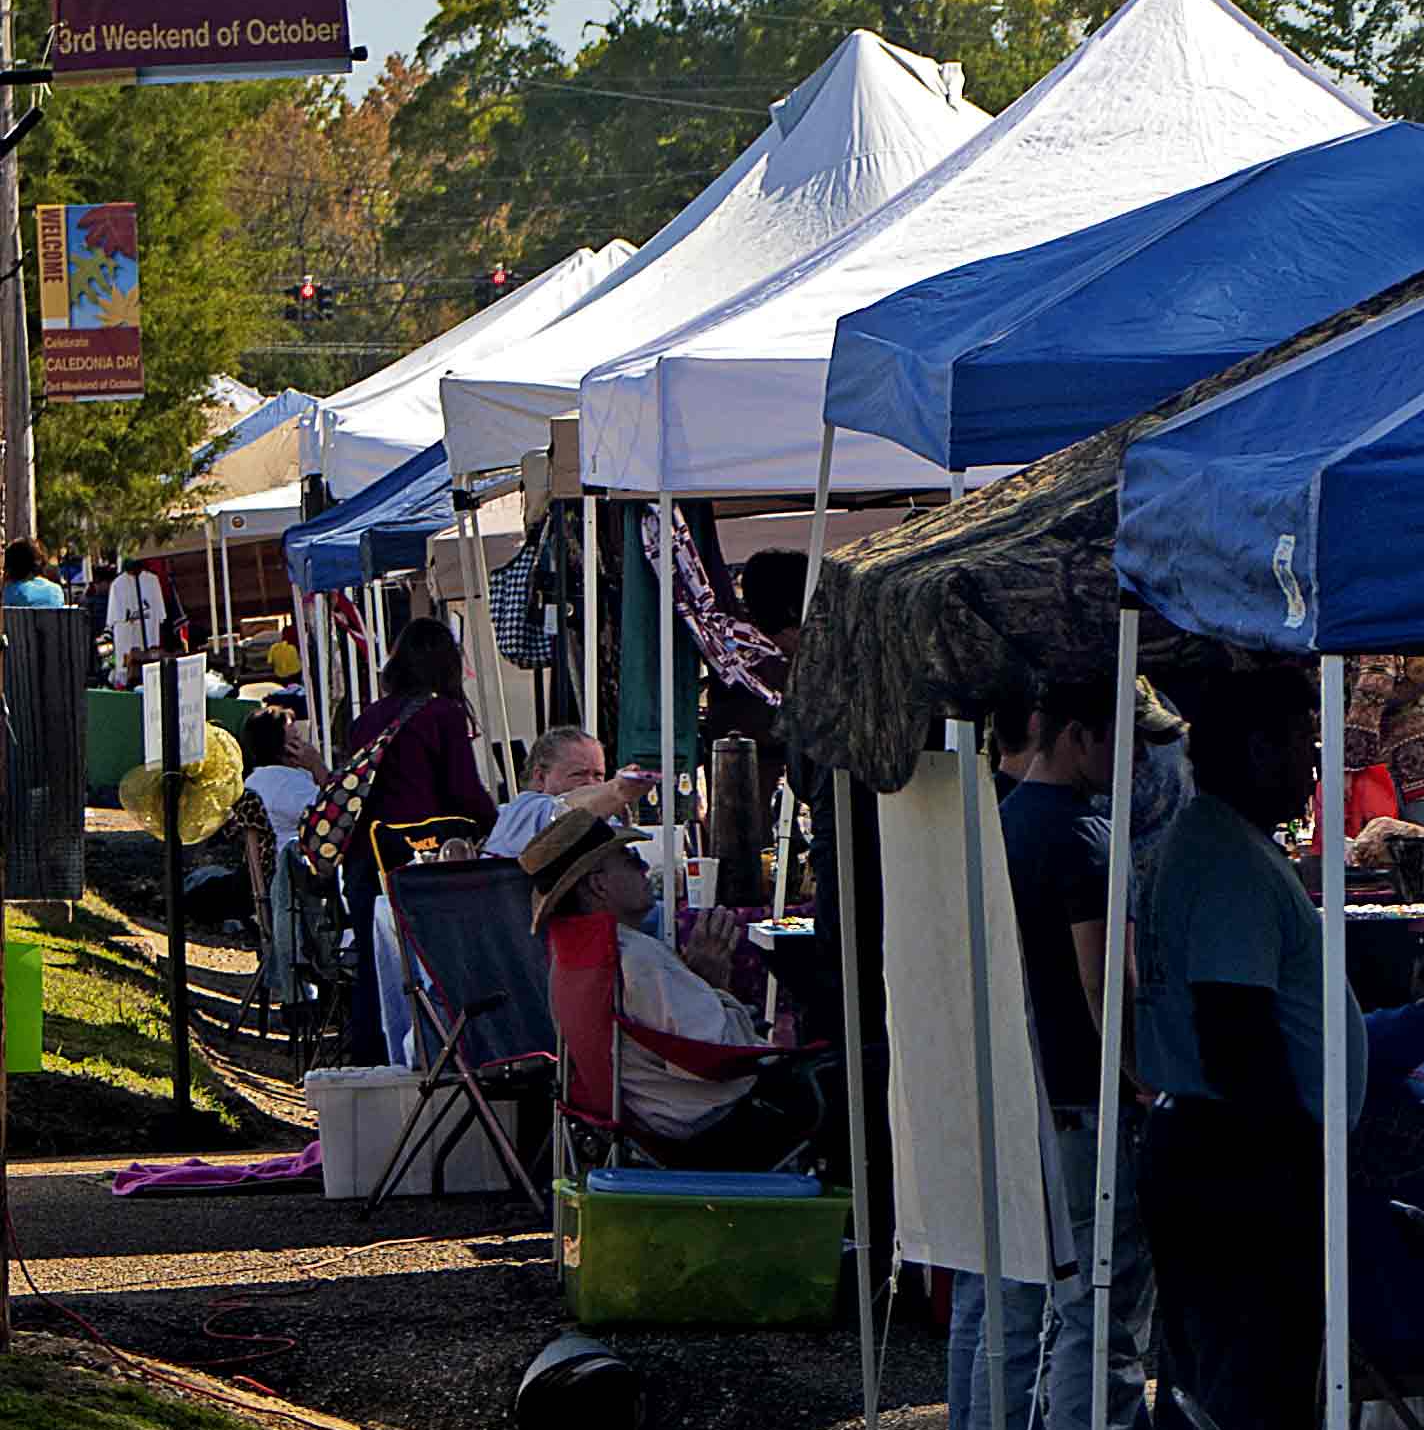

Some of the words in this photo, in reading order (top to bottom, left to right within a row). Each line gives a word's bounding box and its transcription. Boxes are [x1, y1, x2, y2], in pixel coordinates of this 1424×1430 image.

[57, 25, 96, 55] 3rd
[101, 21, 209, 51] Weekend
[216, 20, 241, 47] of
[246, 18, 342, 46] October
[42, 209, 65, 284] WELCOME
[46, 355, 114, 372] CALEDONIA
[116, 355, 141, 370] DAY
